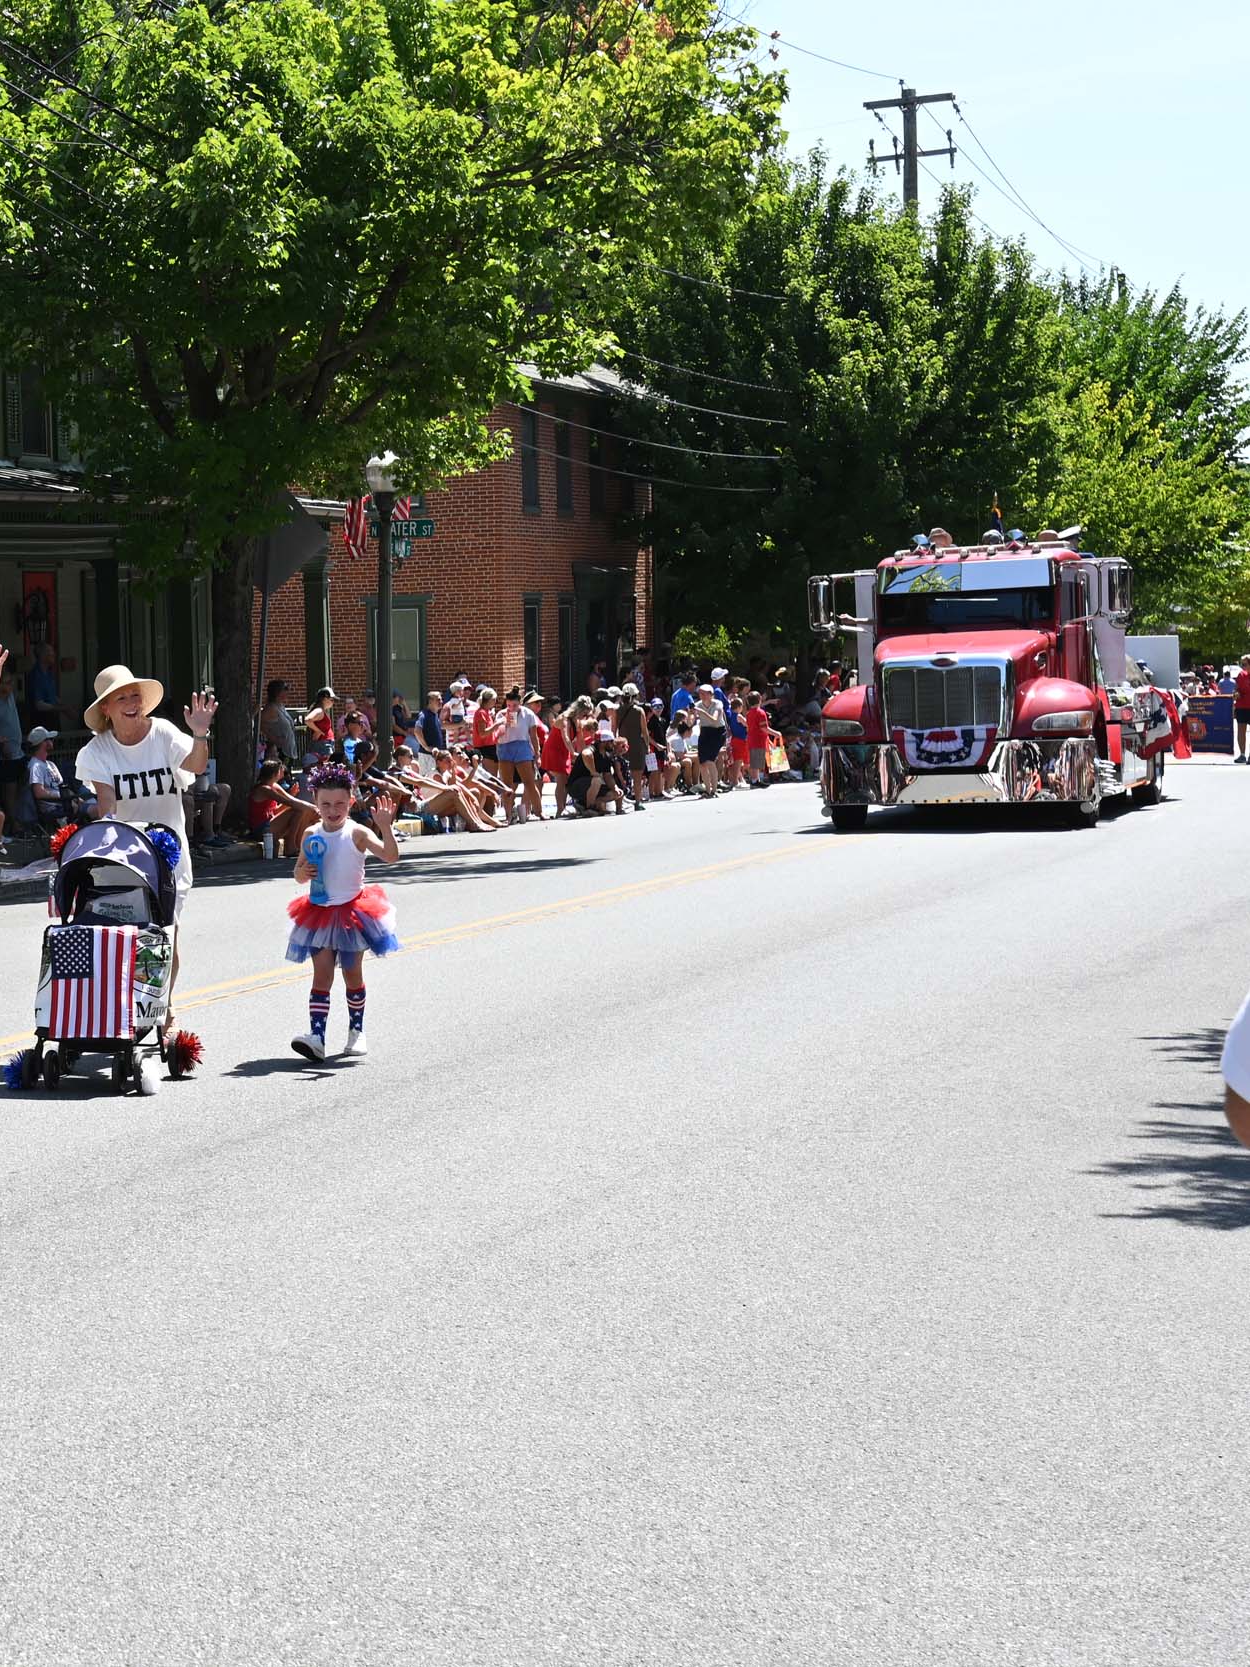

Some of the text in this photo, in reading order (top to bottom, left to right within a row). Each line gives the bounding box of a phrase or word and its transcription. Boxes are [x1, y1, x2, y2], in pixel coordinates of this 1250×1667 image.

[371, 521, 432, 537] N ATER ST
